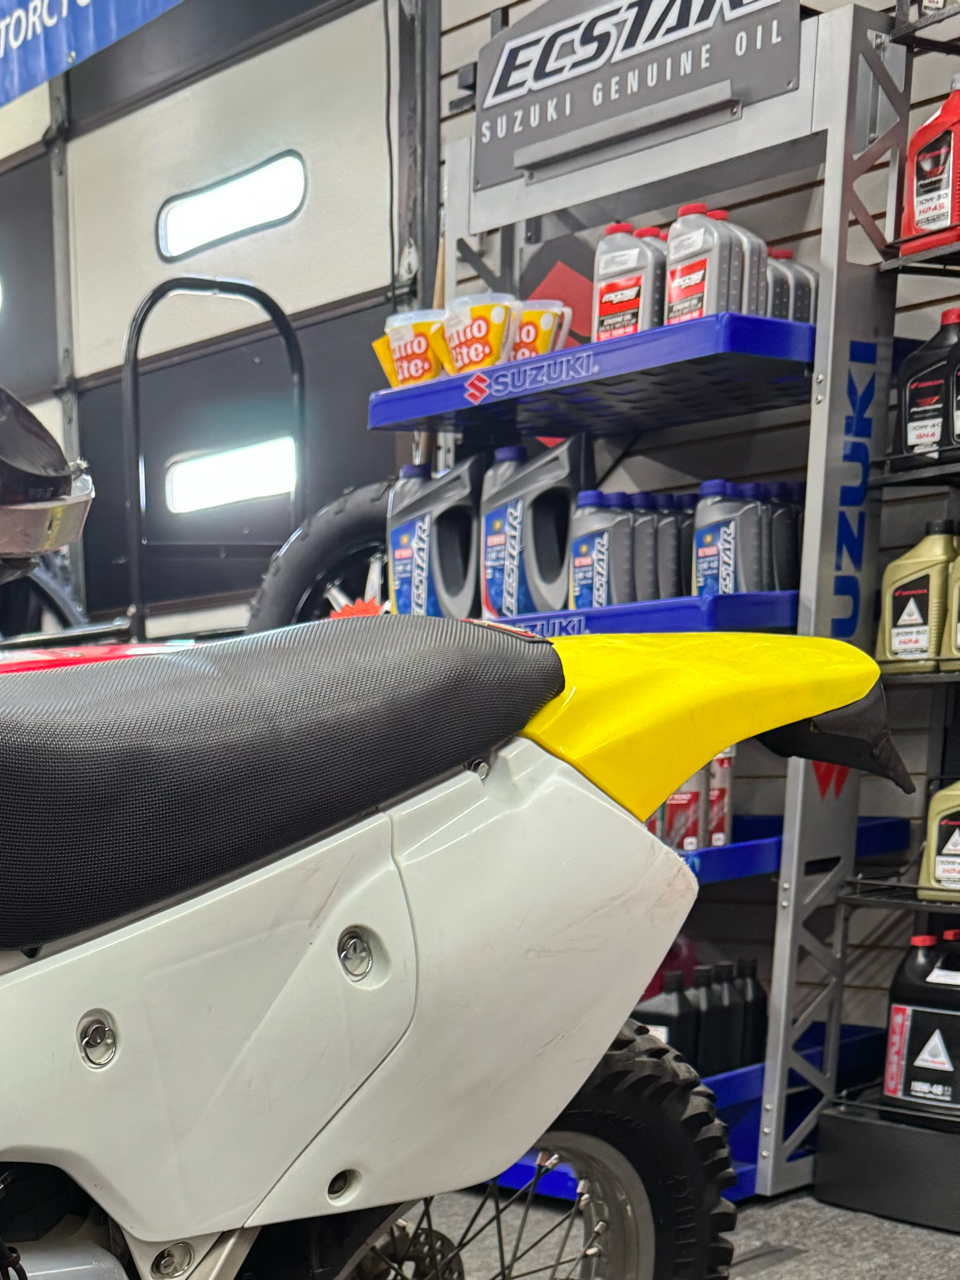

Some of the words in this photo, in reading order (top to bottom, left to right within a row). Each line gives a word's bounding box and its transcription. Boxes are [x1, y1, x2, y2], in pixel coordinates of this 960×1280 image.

[481, 92, 572, 144] SUZUKI
[592, 43, 711, 107] GENUINE
[734, 19, 782, 57] OIL
[491, 351, 594, 397] SUZUKI
[830, 340, 878, 638] UZUKI
[411, 511, 431, 615] CSTAR
